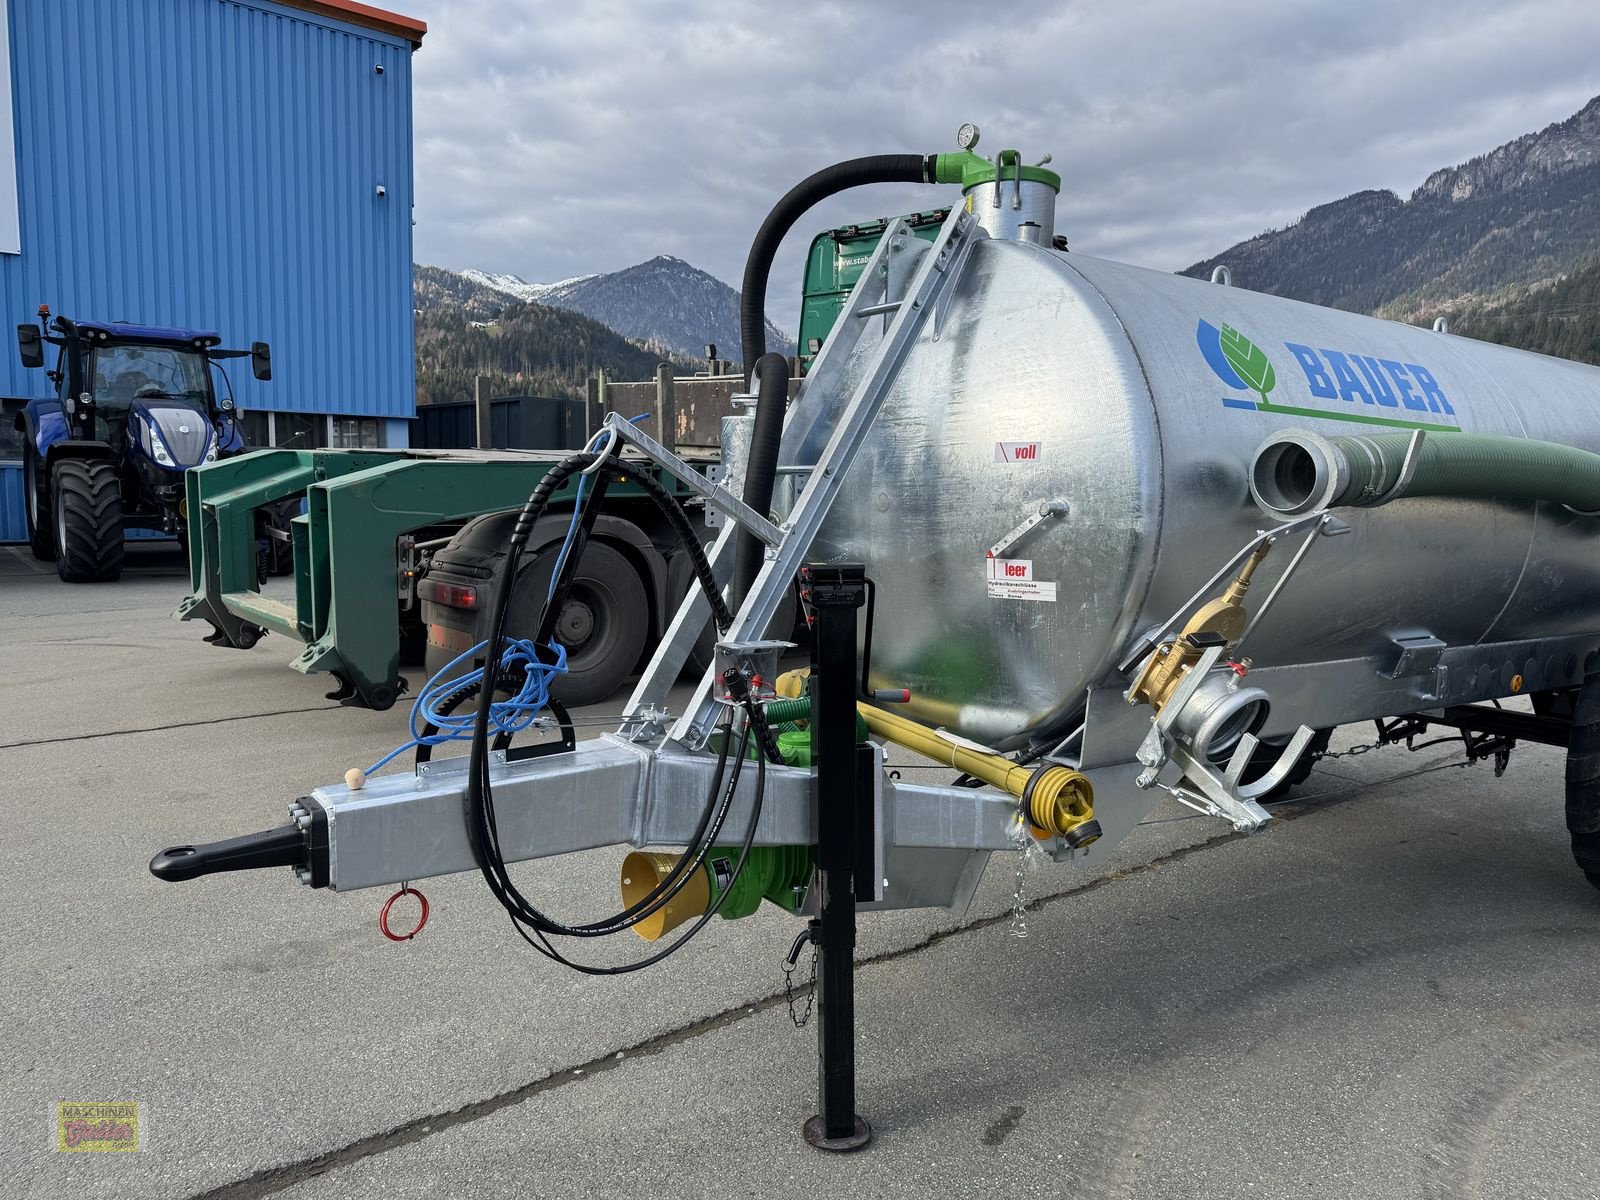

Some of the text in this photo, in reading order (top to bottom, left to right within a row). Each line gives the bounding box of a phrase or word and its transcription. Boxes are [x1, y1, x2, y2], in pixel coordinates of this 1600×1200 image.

[1284, 342, 1456, 416] BAUER
[1014, 445, 1037, 459] voll
[1005, 563, 1026, 577] leer
